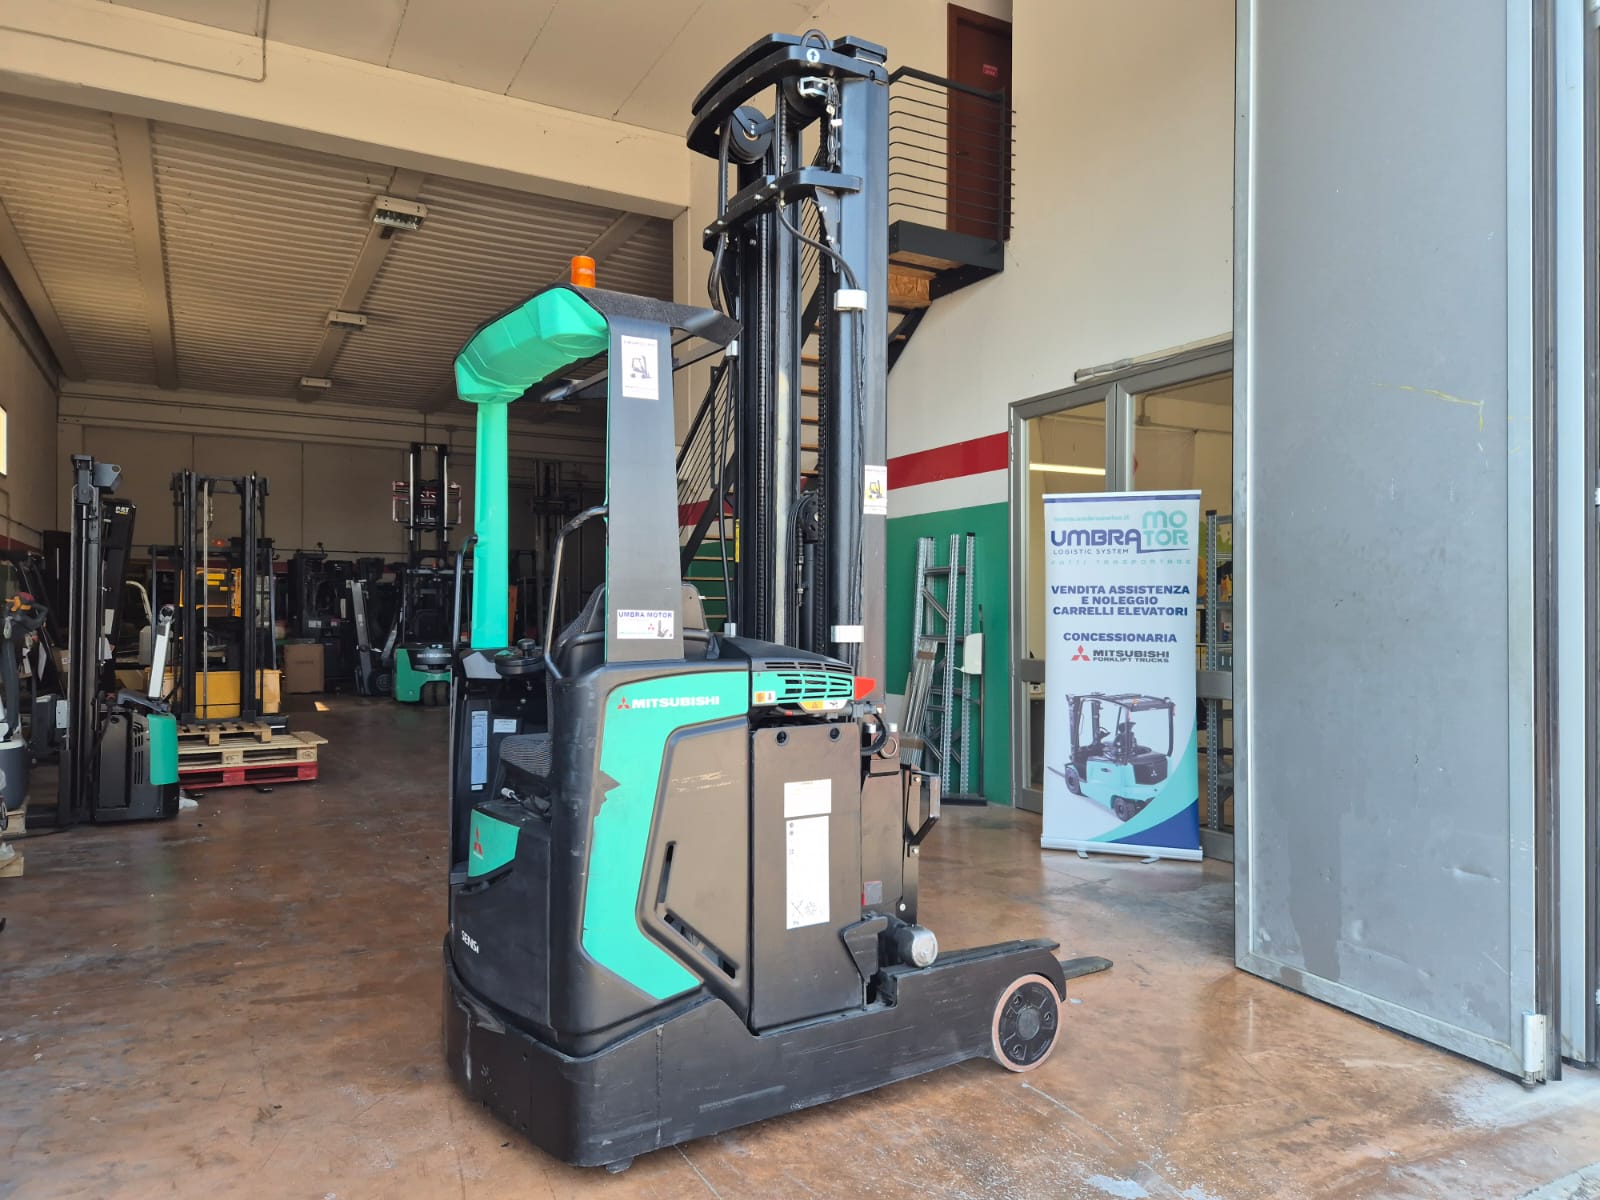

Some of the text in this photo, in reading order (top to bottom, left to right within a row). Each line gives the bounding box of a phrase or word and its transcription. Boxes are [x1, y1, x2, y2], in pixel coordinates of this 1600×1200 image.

[1142, 510, 1188, 529] MO
[1050, 528, 1142, 549] UMBRA
[1143, 529, 1189, 546] TOR
[1051, 585, 1190, 595] VENDITA ASSISTENZA
[1081, 596, 1158, 605] E NOLEGGIO
[647, 611, 672, 619] MOTOR
[1053, 606, 1188, 616] CARRELLI ELEVATORI
[1063, 632, 1177, 643] CONCESSIONARIA
[1093, 649, 1170, 658] MITSUBISHI
[631, 695, 720, 709] MITSUBISHI
